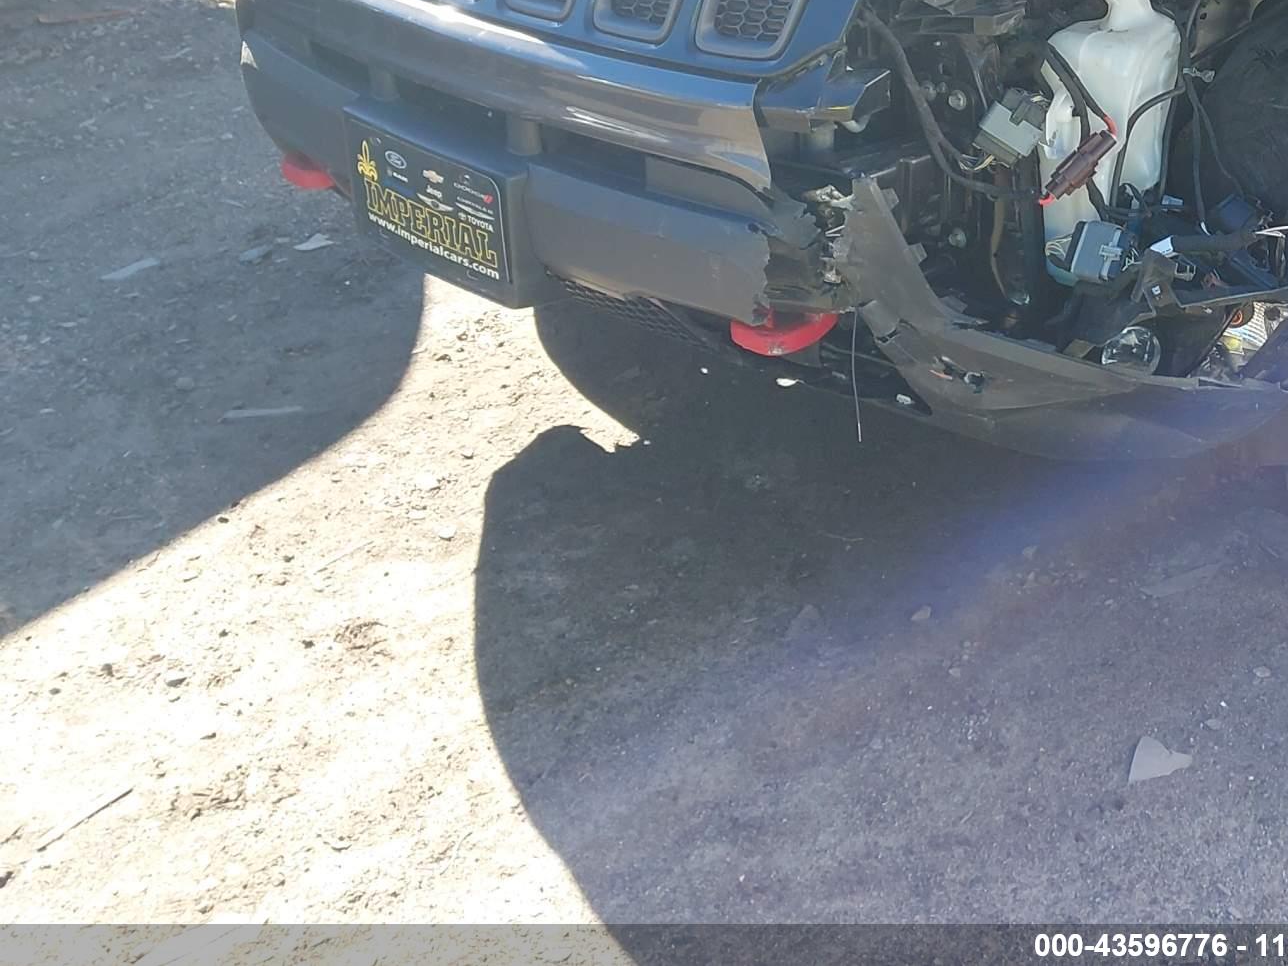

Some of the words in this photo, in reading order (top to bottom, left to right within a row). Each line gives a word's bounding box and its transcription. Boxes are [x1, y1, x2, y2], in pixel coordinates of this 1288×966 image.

[364, 177, 498, 268] IMPERIAL
[368, 212, 500, 280] www.imperialcars.com
[467, 215, 495, 233] TOYOTA
